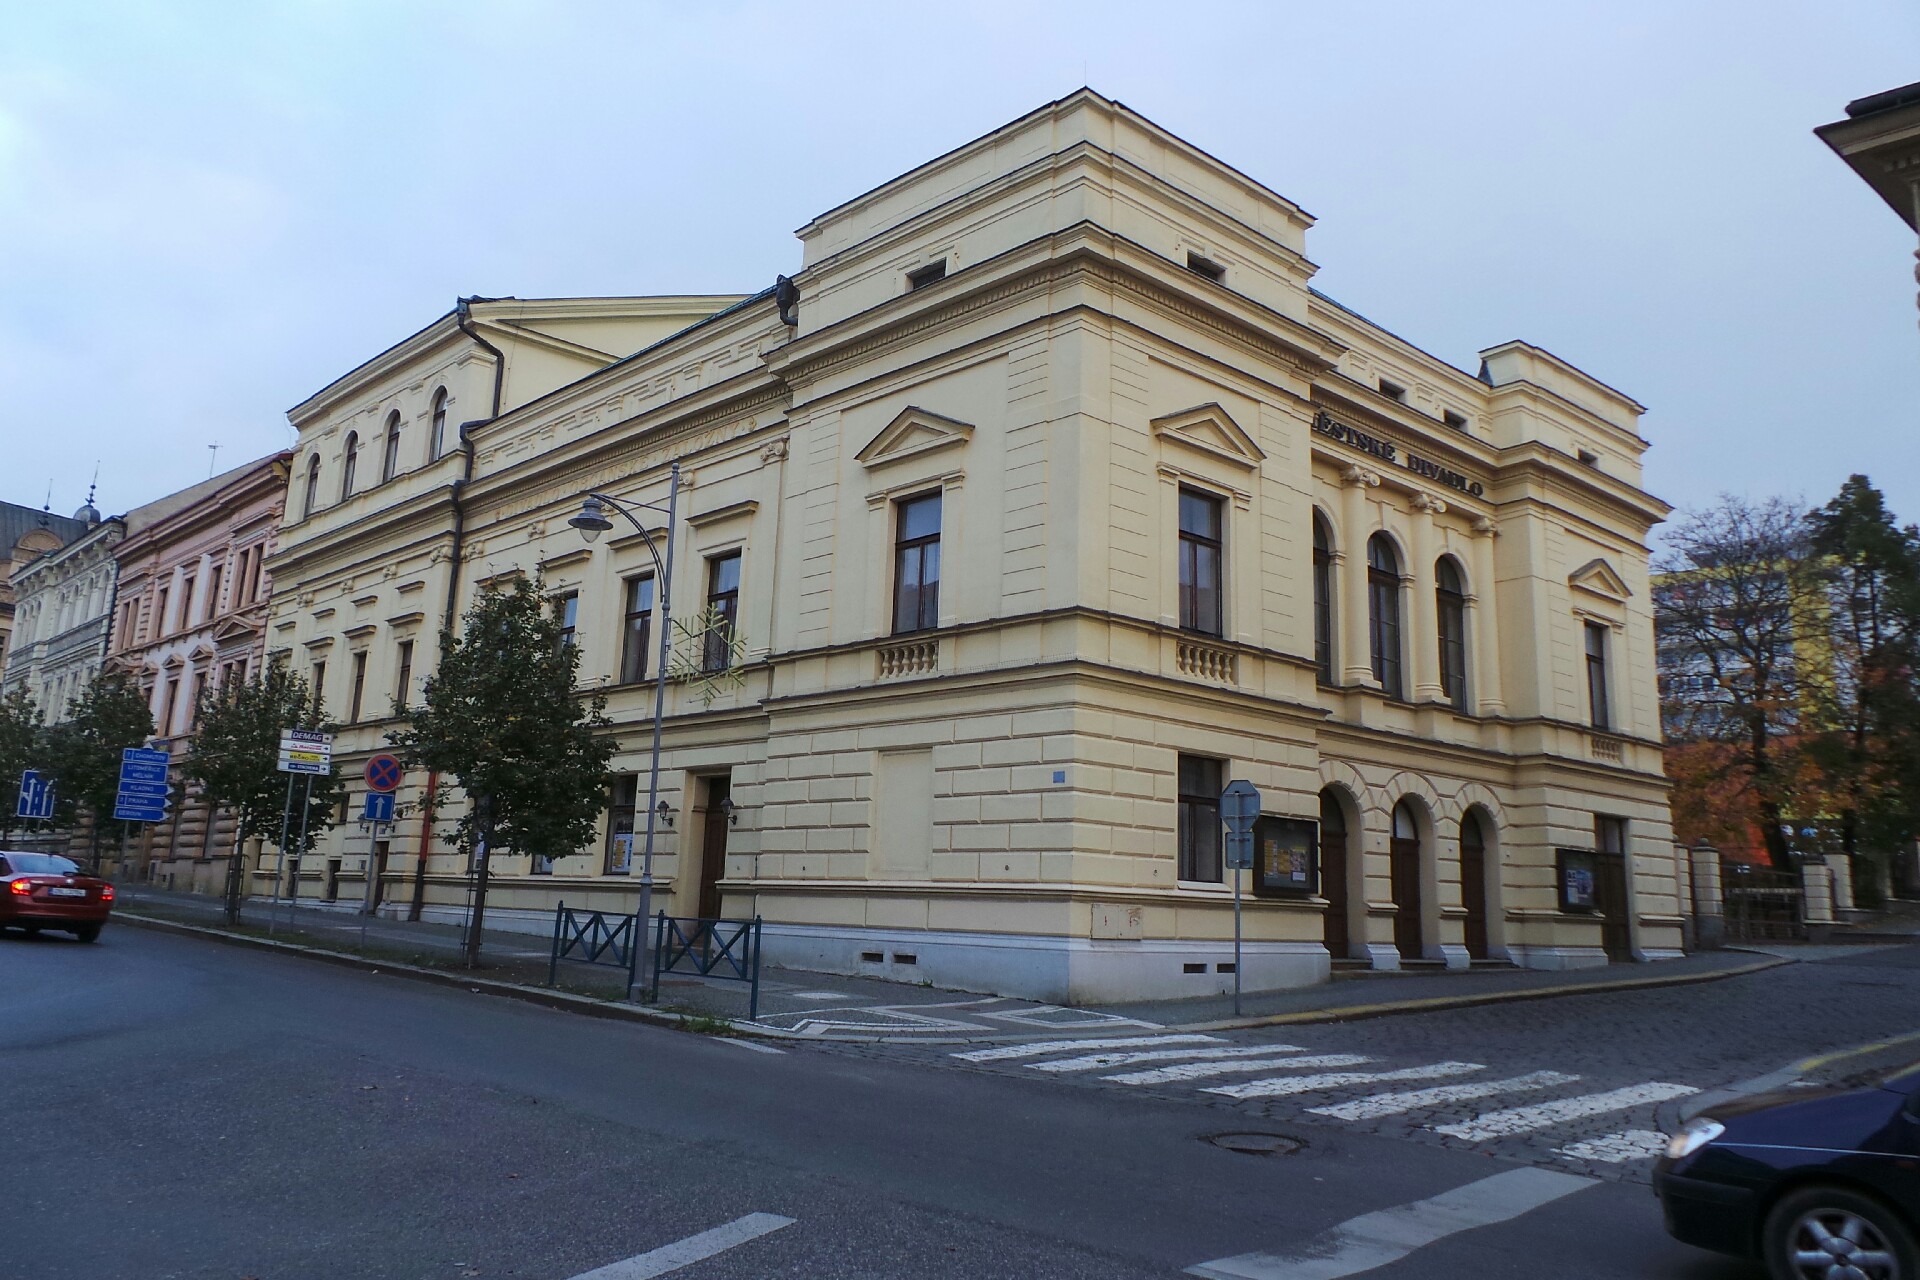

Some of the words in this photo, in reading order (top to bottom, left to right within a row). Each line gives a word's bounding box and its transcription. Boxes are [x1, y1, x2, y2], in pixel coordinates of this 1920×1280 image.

[1407, 453, 1484, 497] DIVADLO
[292, 731, 323, 741] DEMAG
[135, 752, 166, 761] CHOMUTOV
